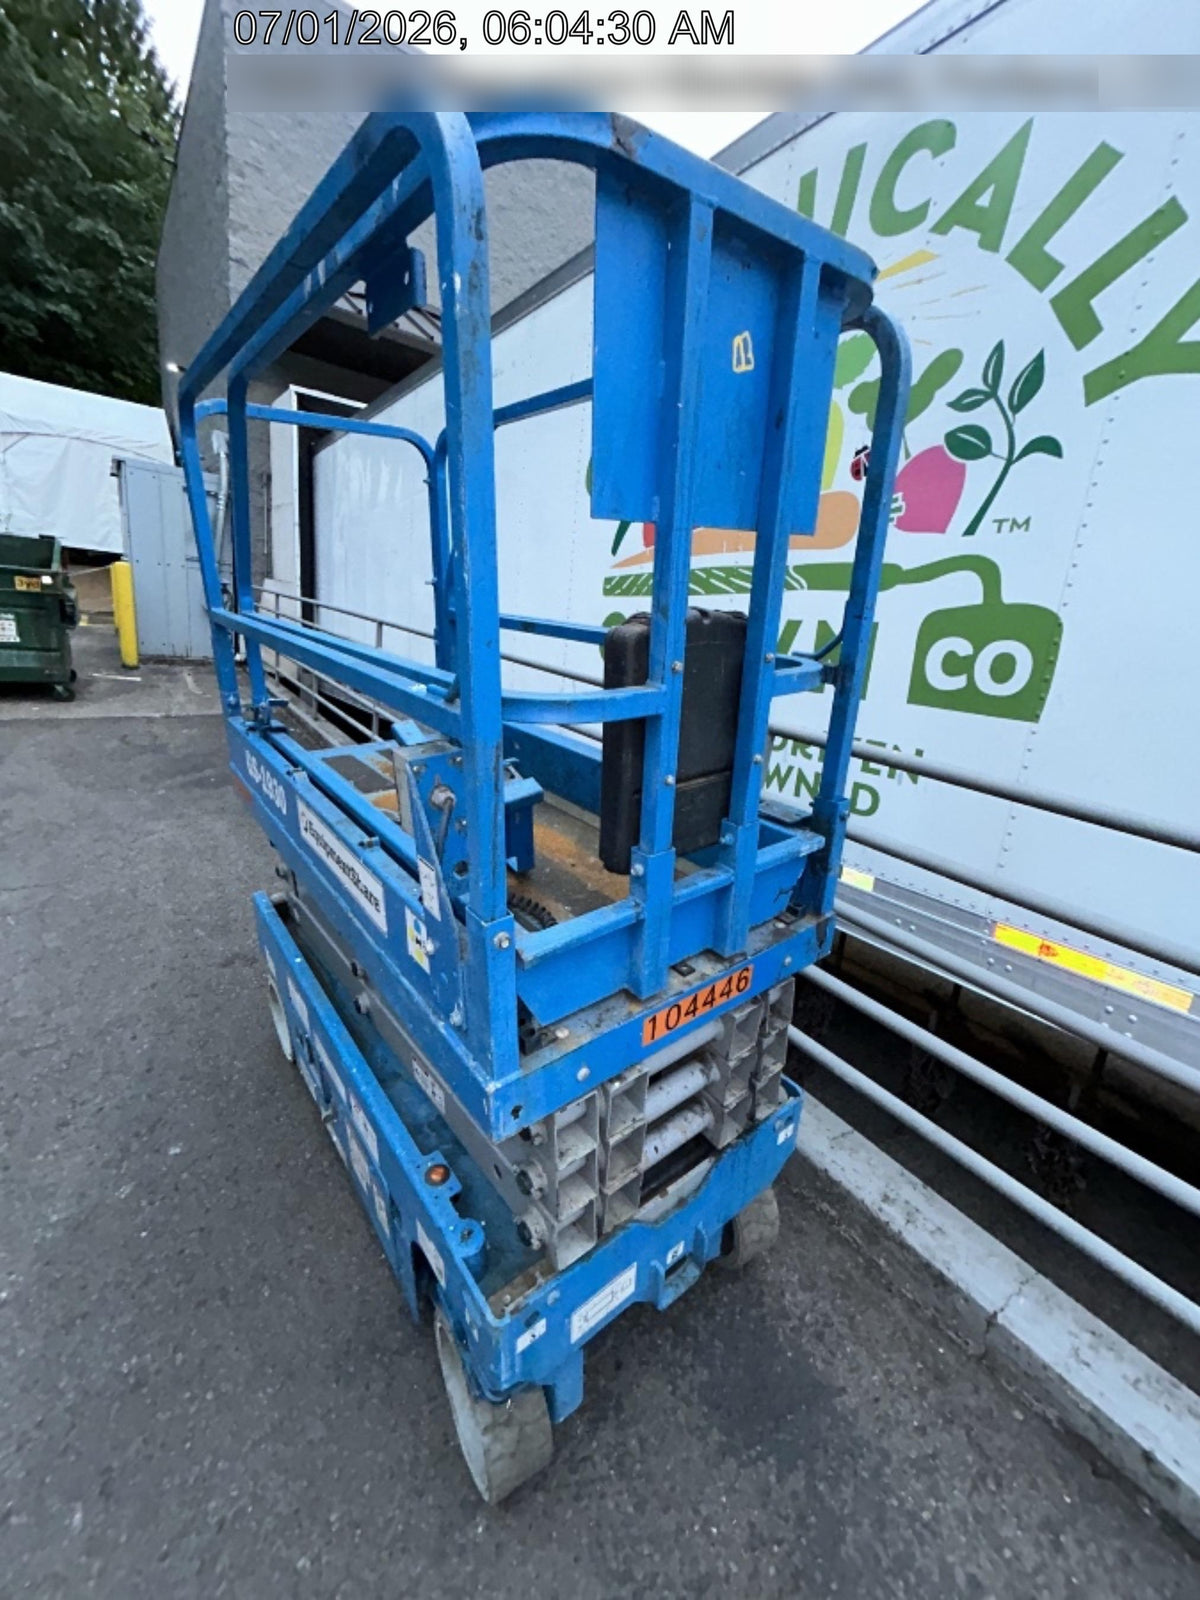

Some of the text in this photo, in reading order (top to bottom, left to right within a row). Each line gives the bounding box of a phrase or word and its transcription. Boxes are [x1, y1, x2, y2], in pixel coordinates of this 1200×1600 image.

[992, 516, 1032, 534] TM
[924, 636, 1034, 696] CO
[648, 966, 750, 1041] 104446
